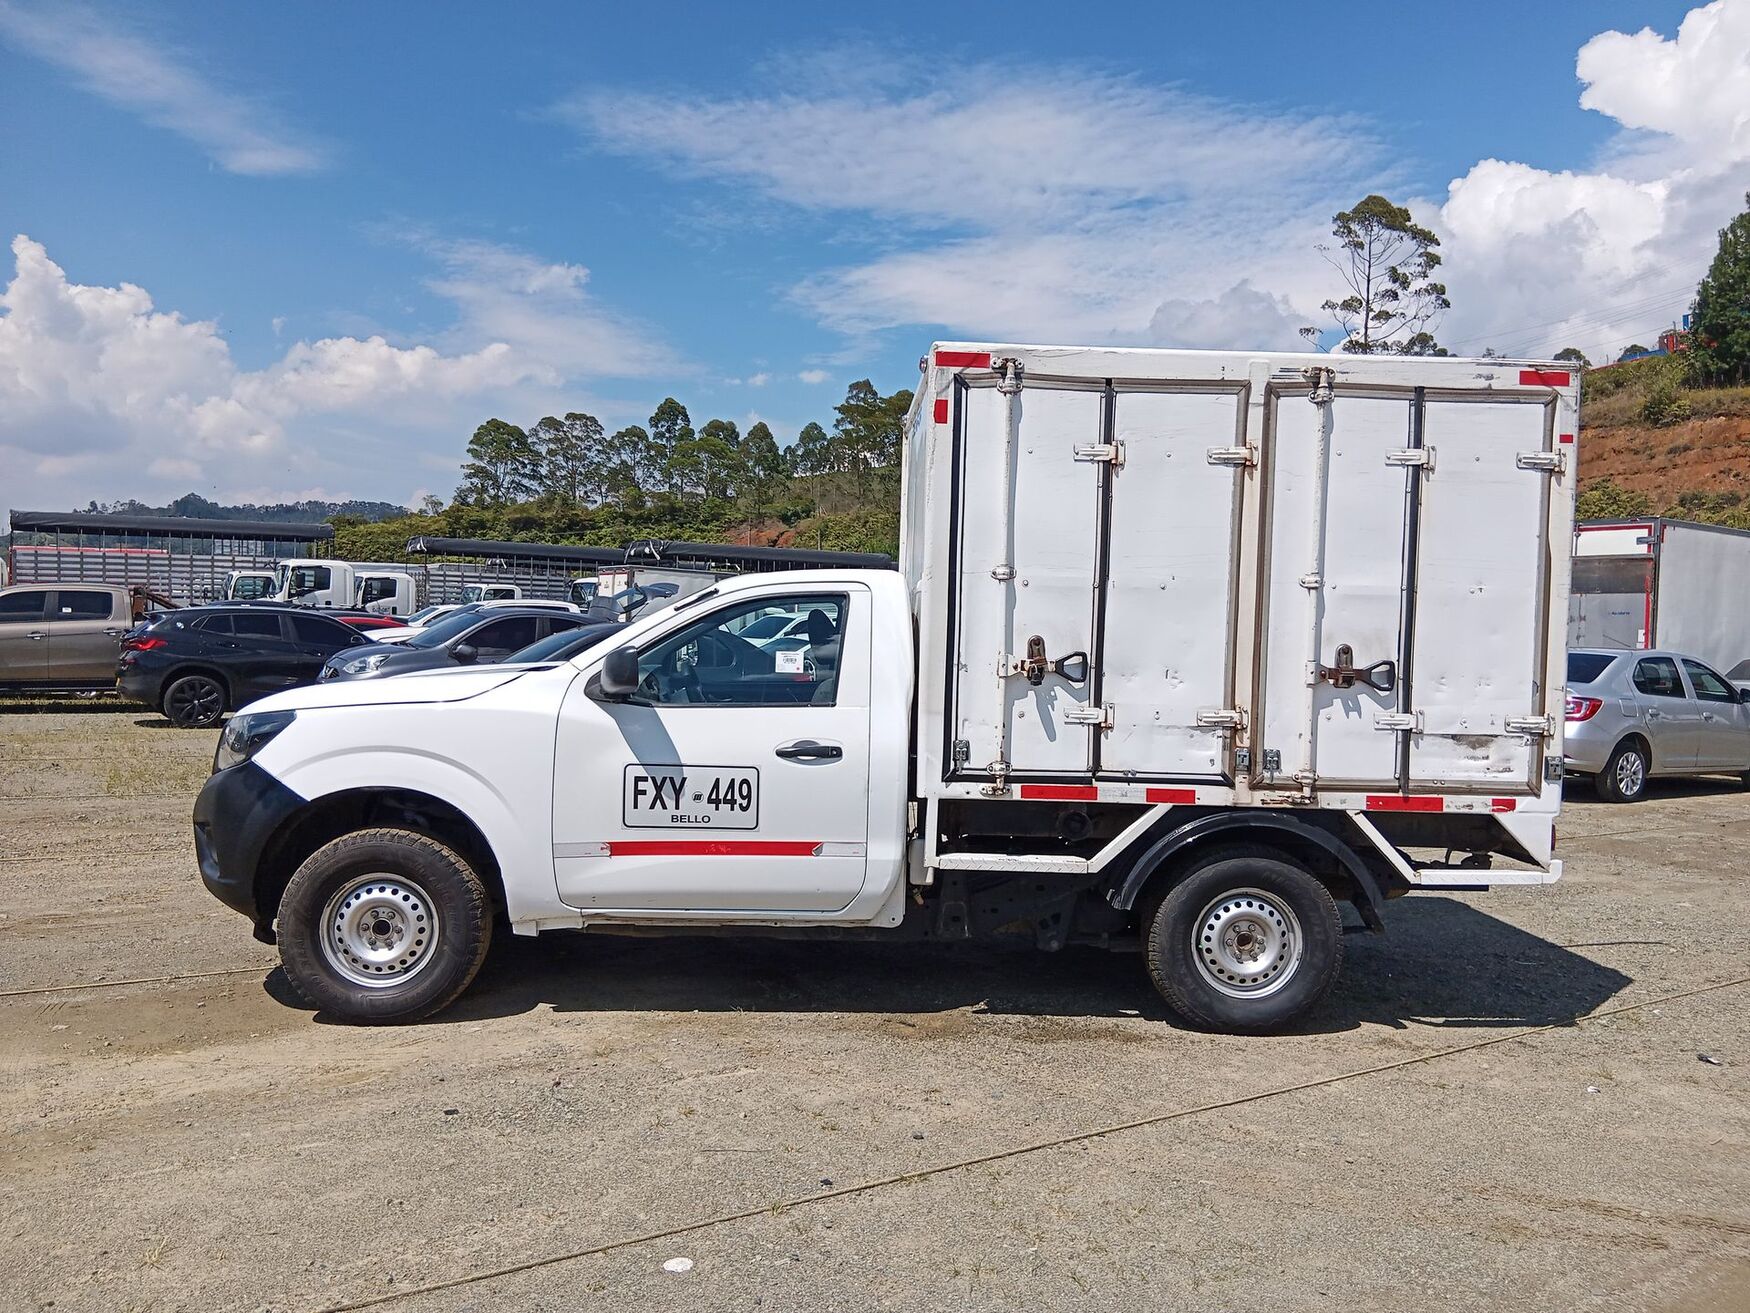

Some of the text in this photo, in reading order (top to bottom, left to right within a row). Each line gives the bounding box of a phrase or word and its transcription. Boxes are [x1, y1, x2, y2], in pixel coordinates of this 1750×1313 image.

[632, 775, 753, 812] FXY 449
[670, 814, 711, 824] BELLO
